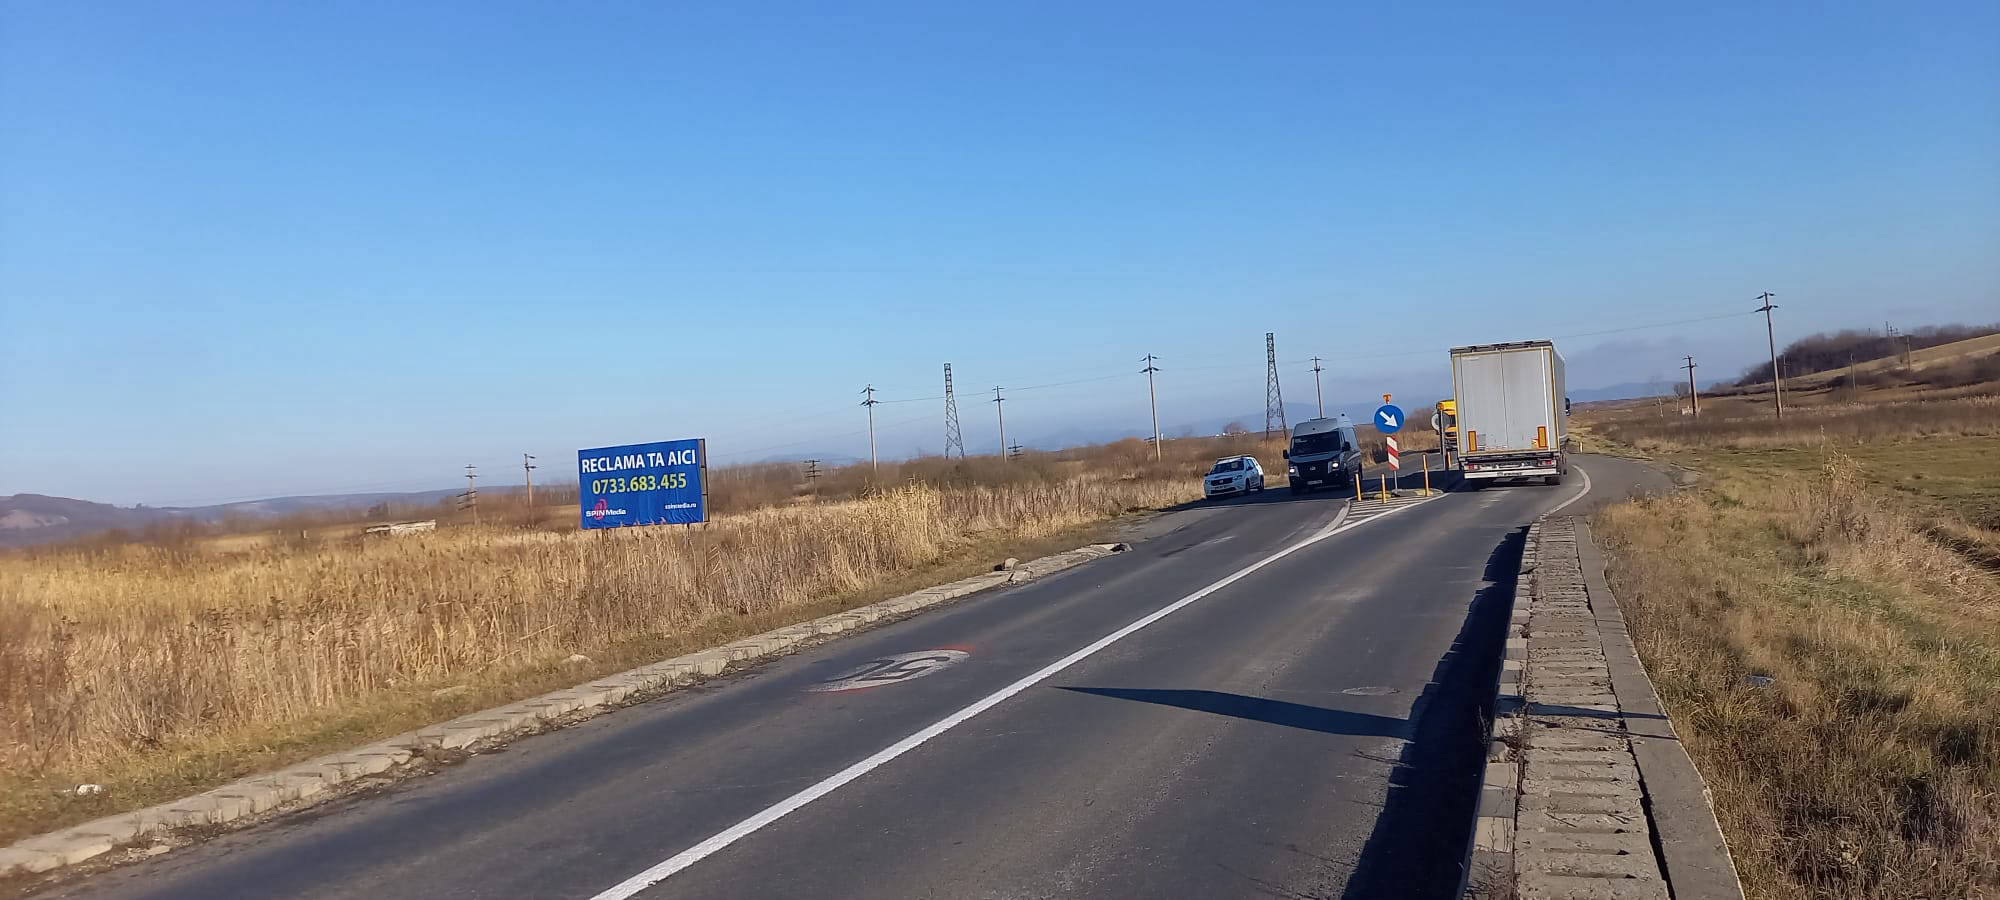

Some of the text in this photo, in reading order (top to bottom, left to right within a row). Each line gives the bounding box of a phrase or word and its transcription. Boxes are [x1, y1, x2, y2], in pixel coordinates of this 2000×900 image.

[582, 450, 696, 473] RECLAMA TA AICI
[592, 473, 687, 494] 0733.683.455
